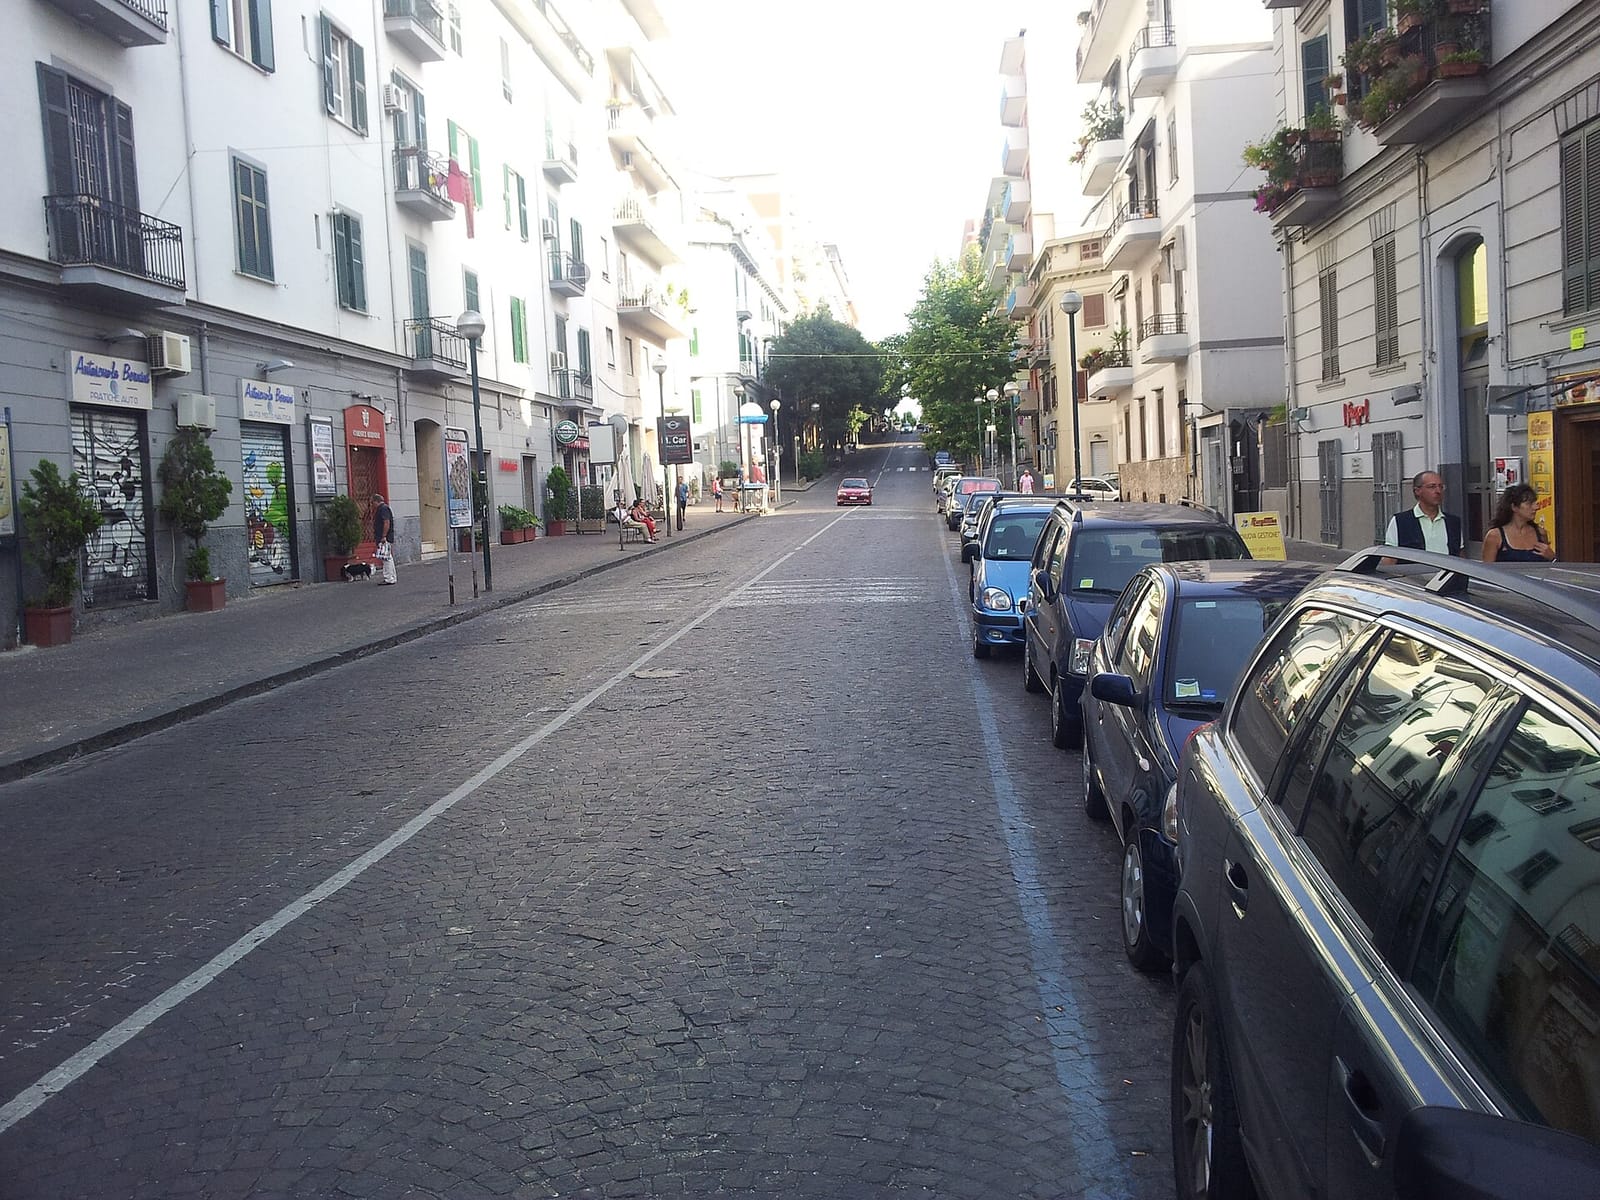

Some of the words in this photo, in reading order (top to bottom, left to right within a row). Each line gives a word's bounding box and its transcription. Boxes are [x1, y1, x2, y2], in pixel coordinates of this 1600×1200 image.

[75, 356, 119, 379] Autoscuola
[90, 391, 120, 403] PRATICHE
[672, 436, 687, 444] Car
